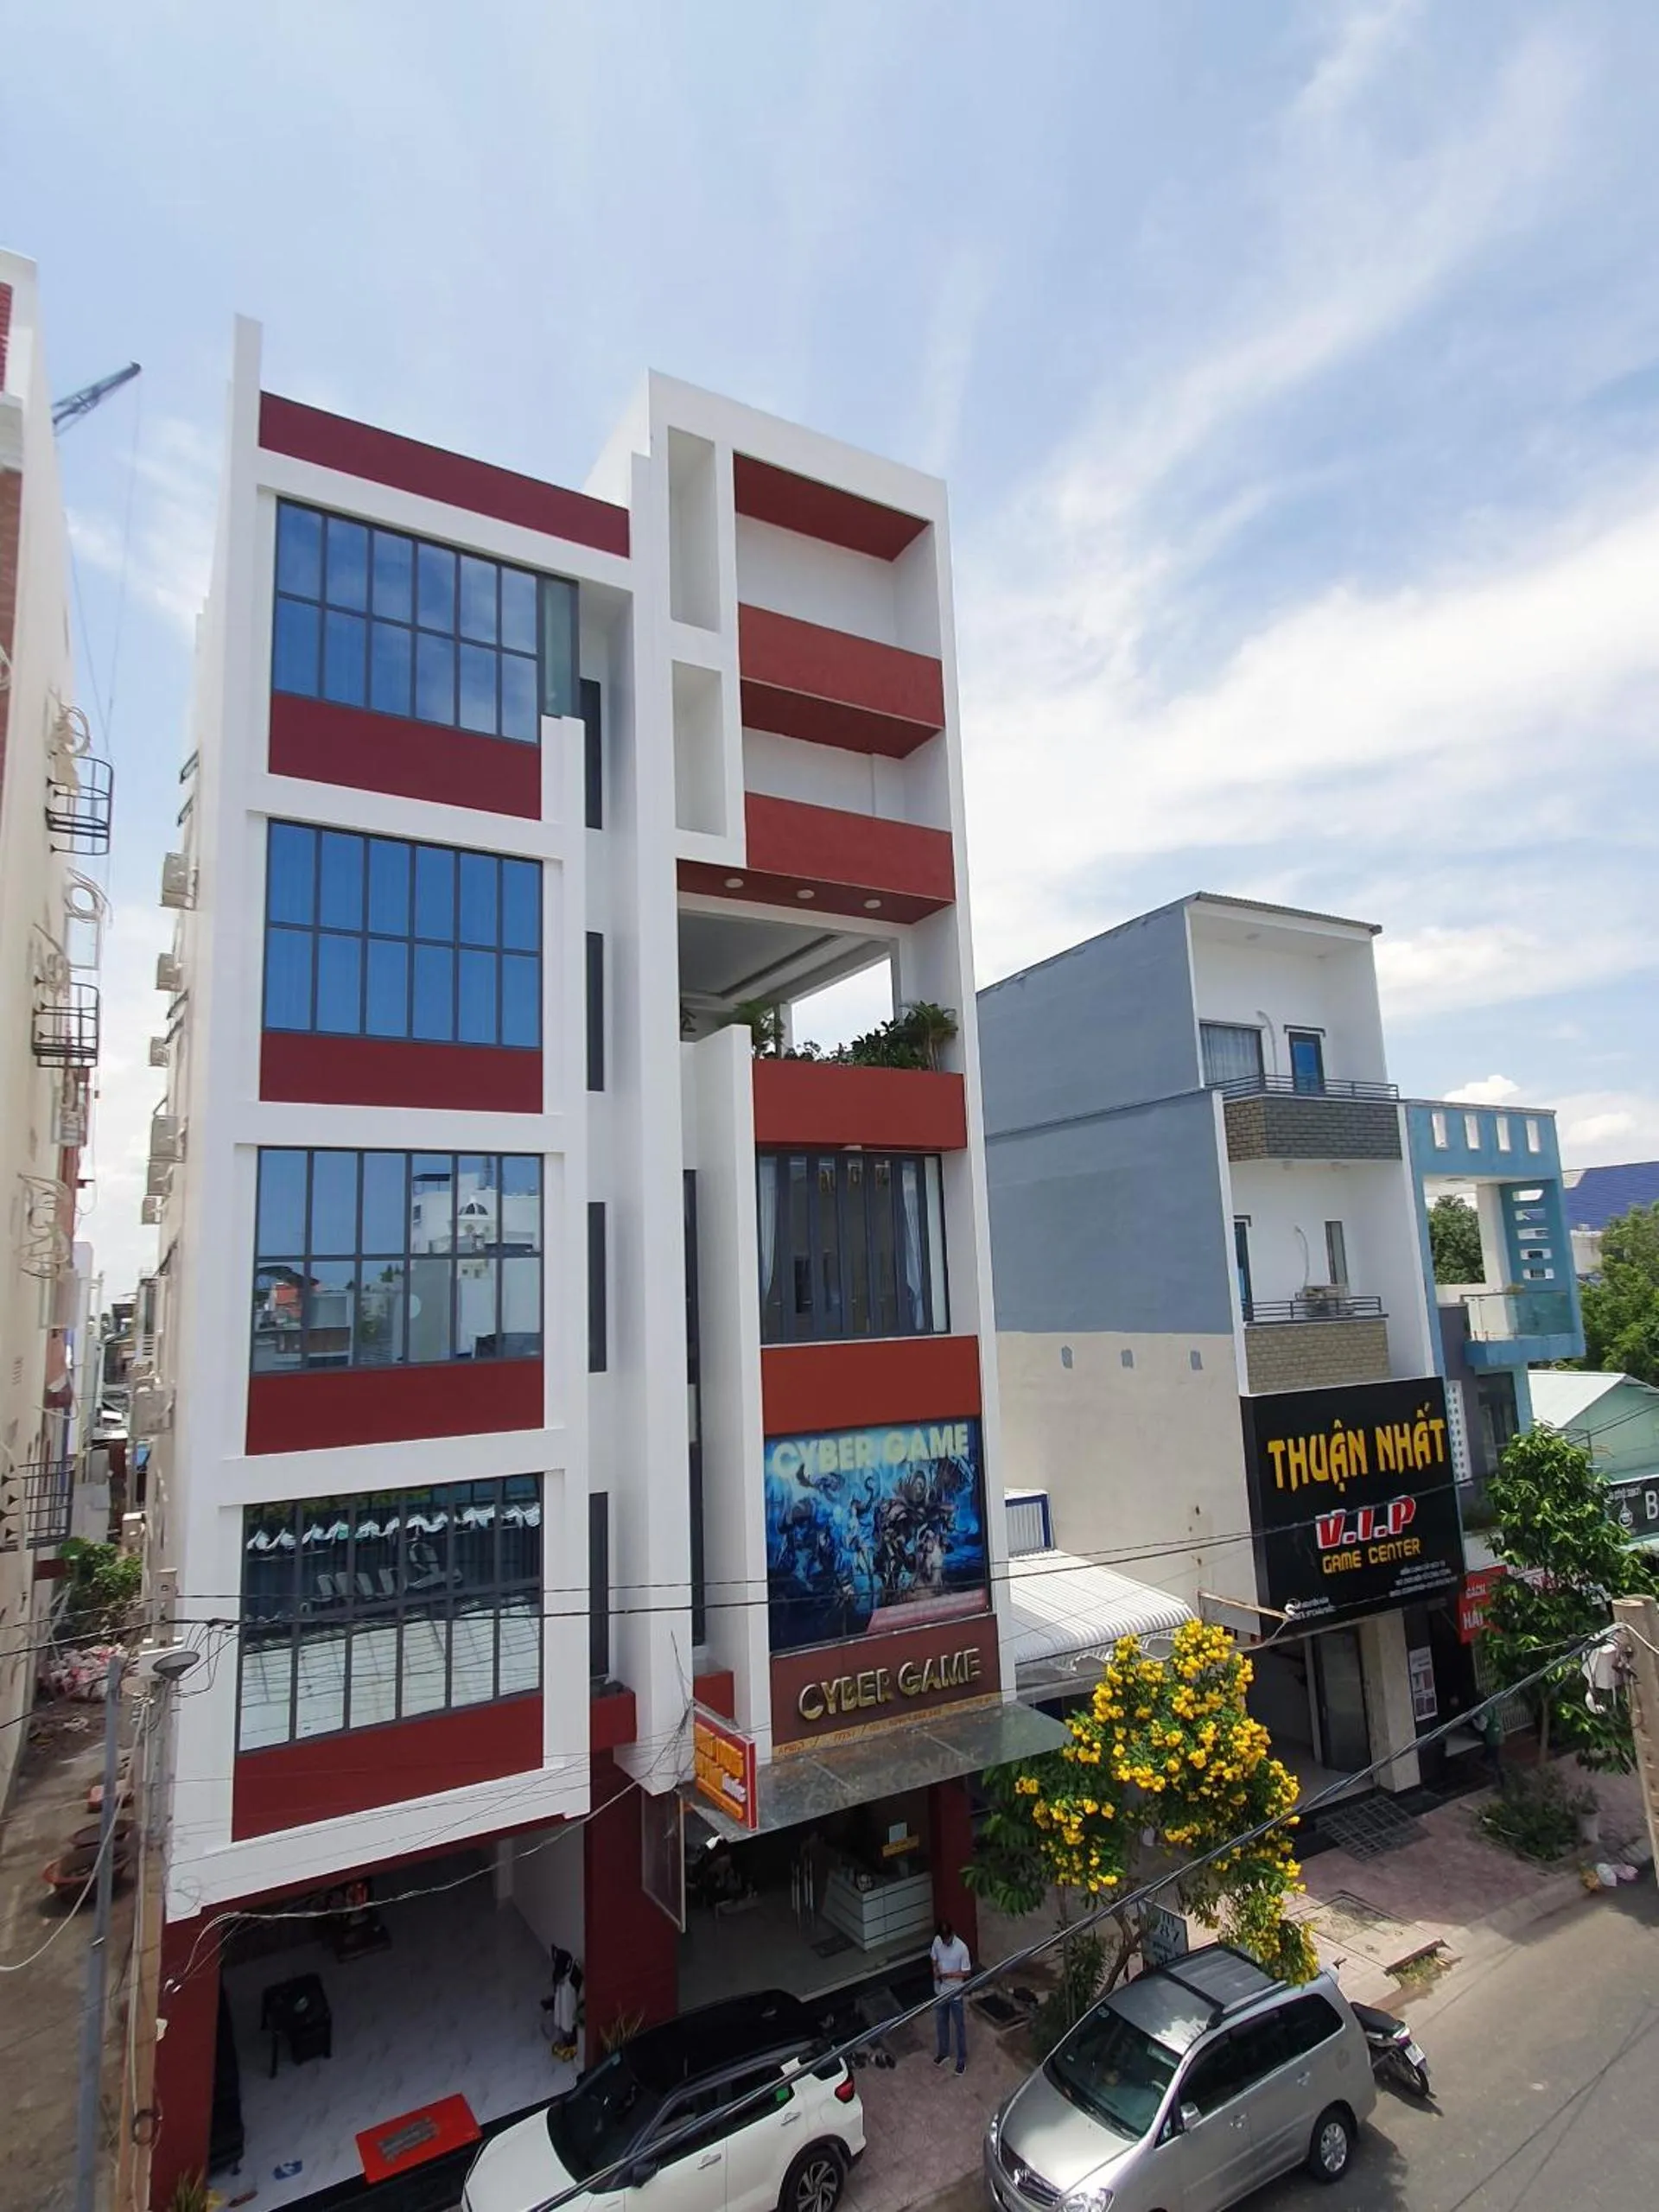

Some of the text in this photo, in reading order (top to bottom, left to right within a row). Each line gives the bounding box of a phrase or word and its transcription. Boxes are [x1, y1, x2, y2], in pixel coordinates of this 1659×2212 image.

[772, 1424, 969, 1478] CYBER GAME
[1268, 1402, 1446, 1493] THUẬN NHẤT
[1322, 1538, 1421, 1573] GAME CENTER
[798, 1668, 895, 1720] CYBER
[897, 1647, 983, 1696] GAME
